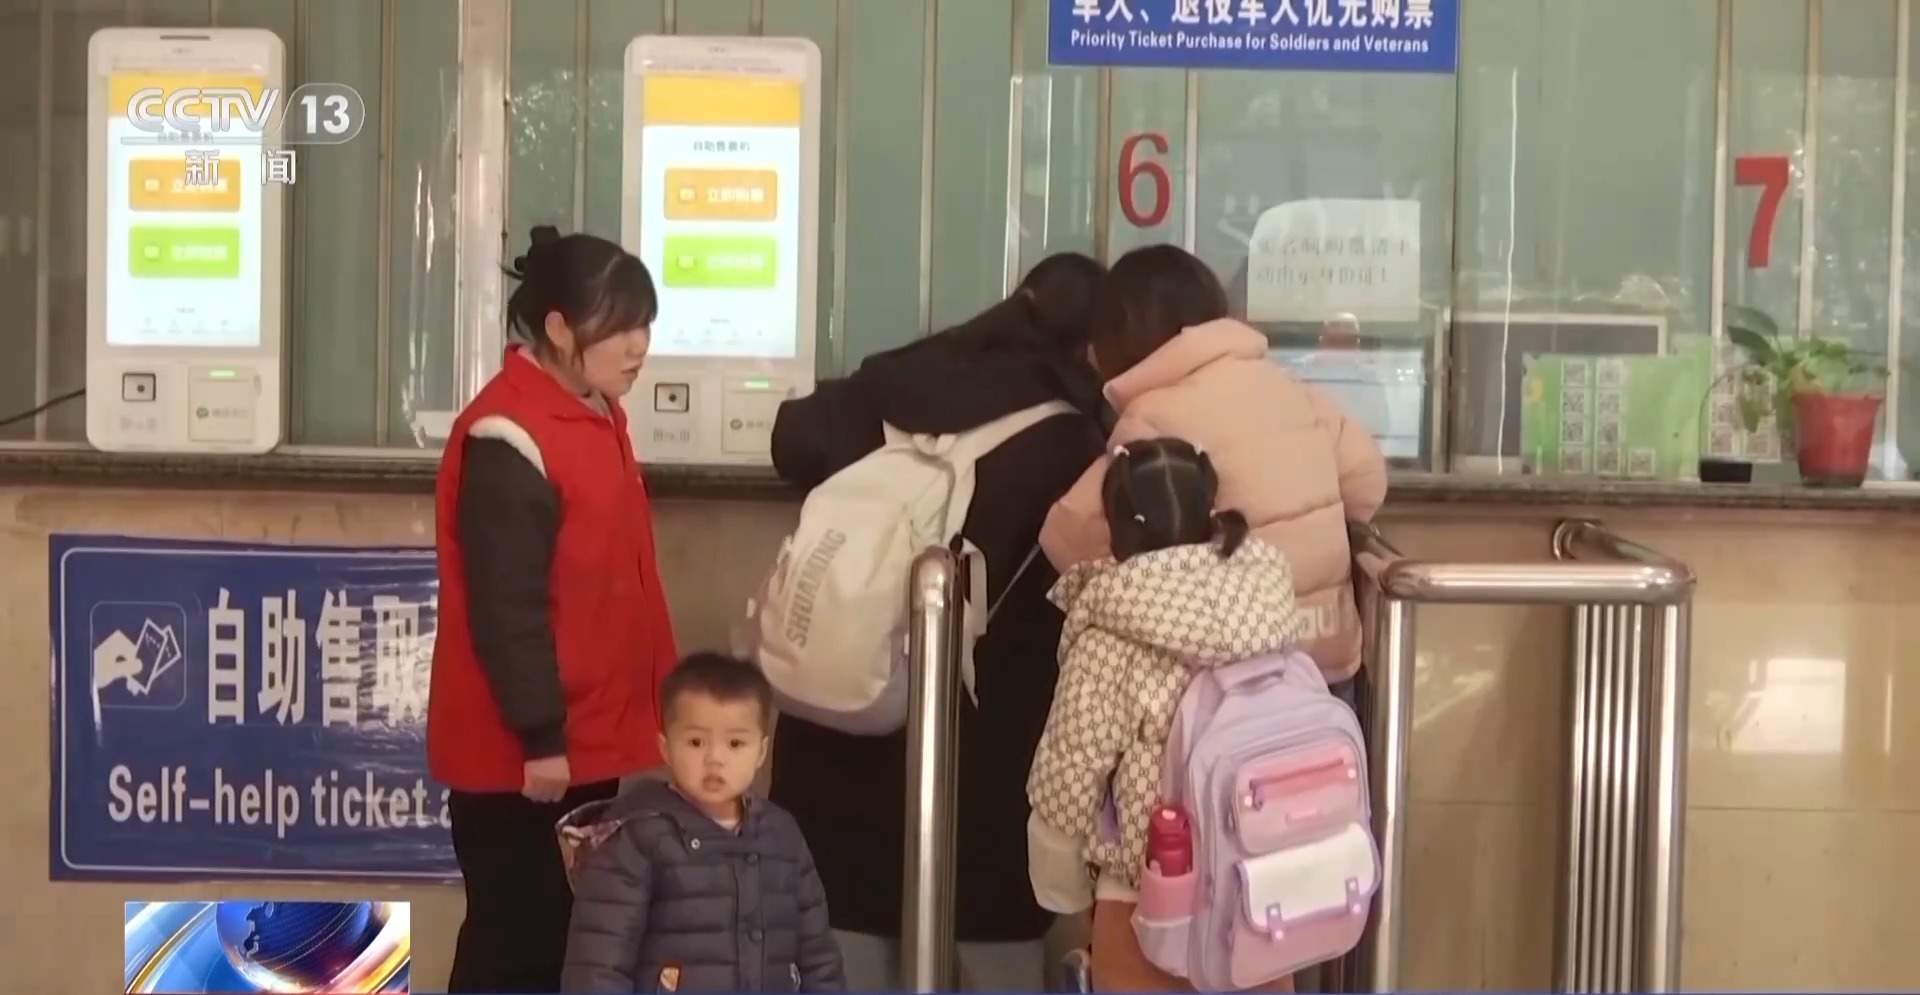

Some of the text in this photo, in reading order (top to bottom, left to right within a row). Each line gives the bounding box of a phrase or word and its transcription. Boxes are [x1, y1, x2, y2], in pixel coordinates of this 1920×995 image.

[1071, 29, 1429, 52] Priority Ticket Purchase for Soldiers and Veterans
[1118, 133, 1170, 228] 6
[1735, 157, 1788, 268] 7
[108, 764, 300, 839] Self-help
[311, 770, 432, 829] ticket
